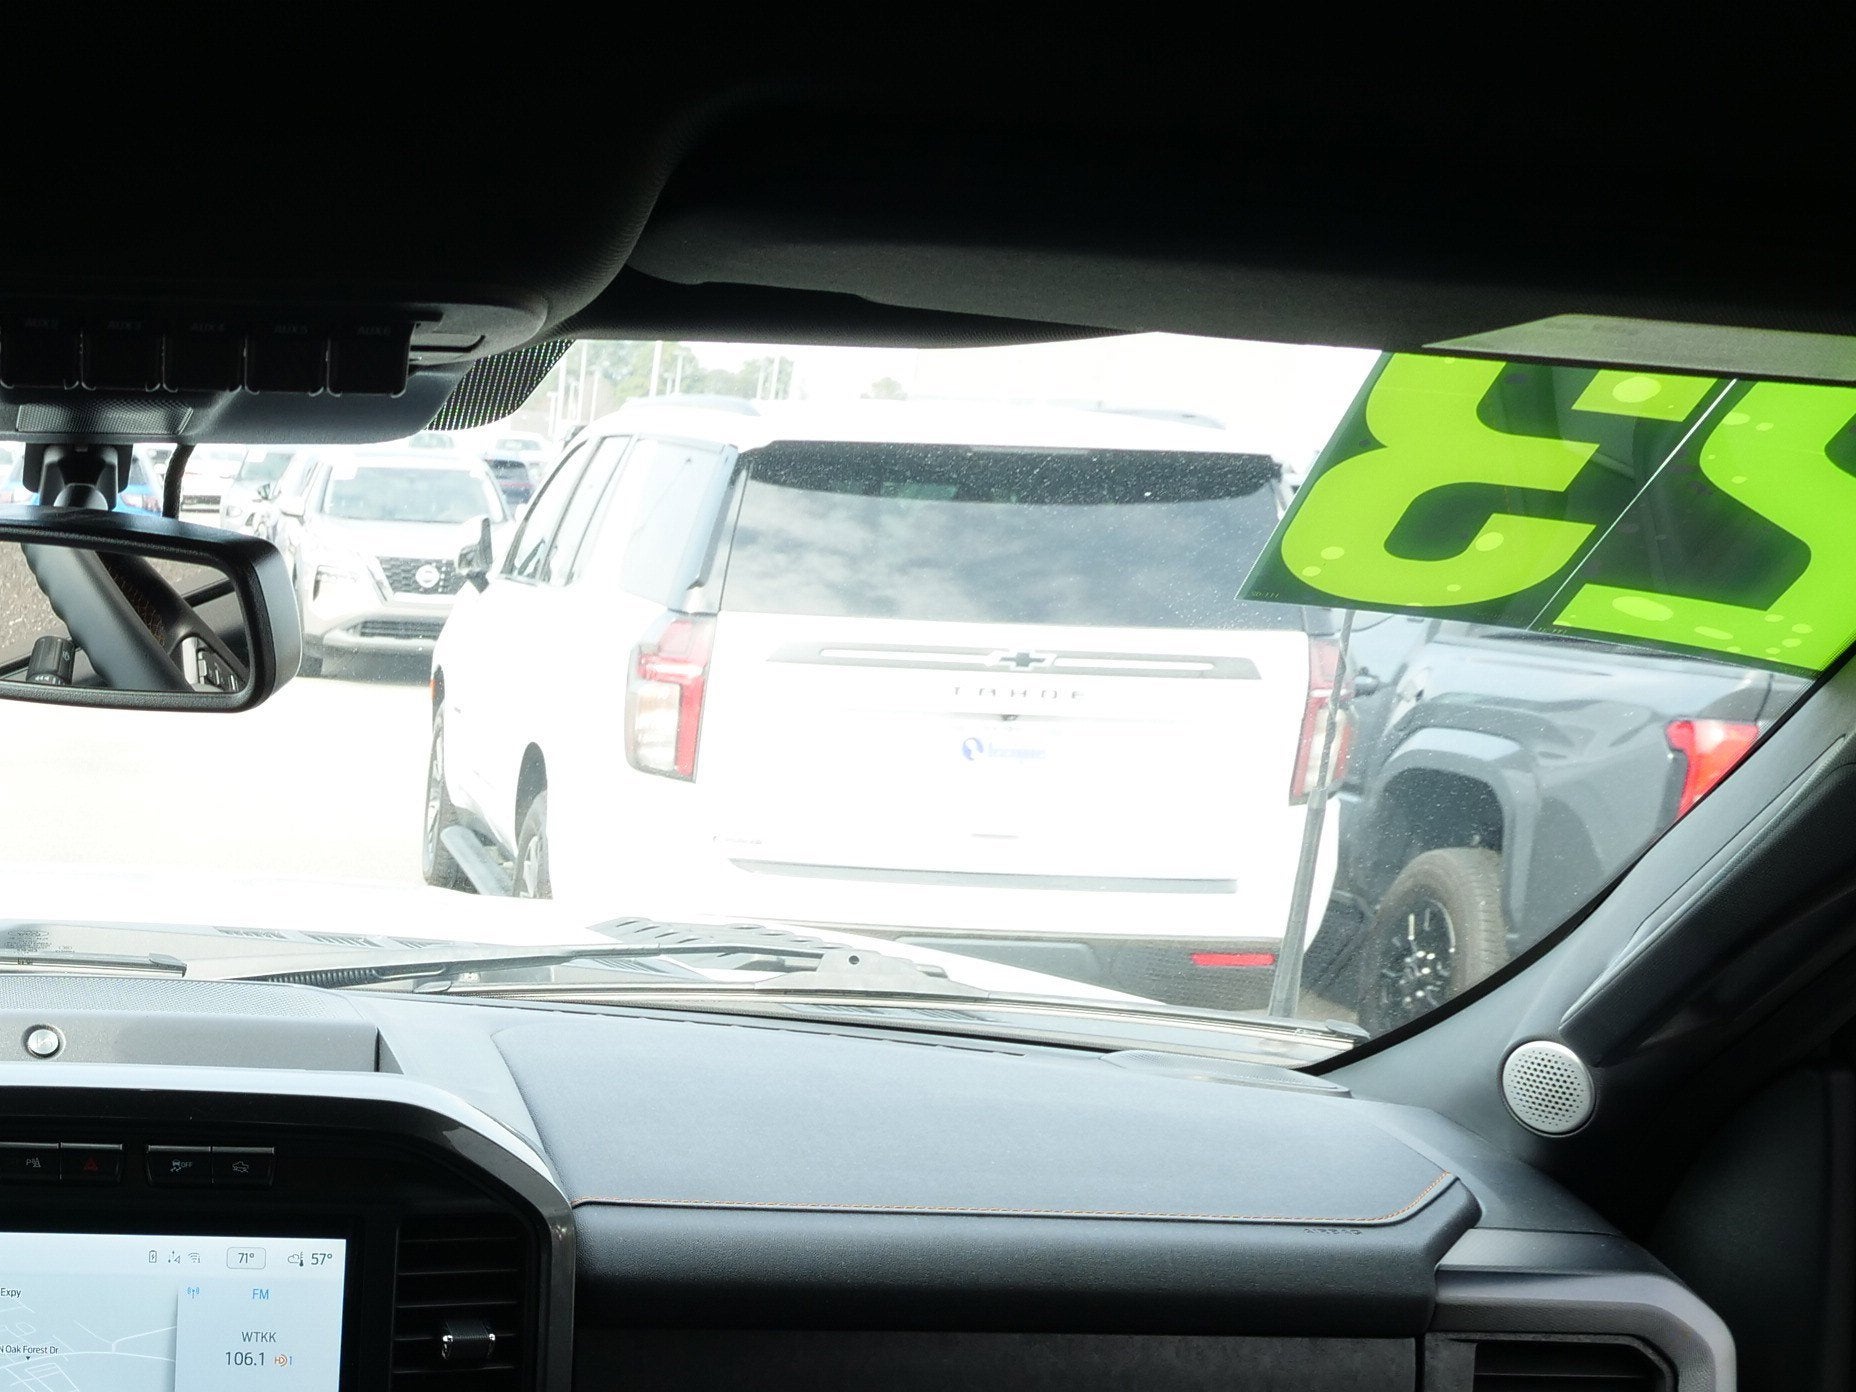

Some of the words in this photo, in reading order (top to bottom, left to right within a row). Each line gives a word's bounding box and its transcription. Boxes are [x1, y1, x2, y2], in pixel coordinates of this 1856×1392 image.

[0, 1288, 21, 1299] Expy
[252, 1289, 269, 1300] FM
[241, 1332, 277, 1343] WTKK
[5, 1345, 21, 1354] Oak
[22, 1345, 48, 1355] Forest
[50, 1346, 59, 1355] Dr
[225, 1352, 265, 1366] 106.1
